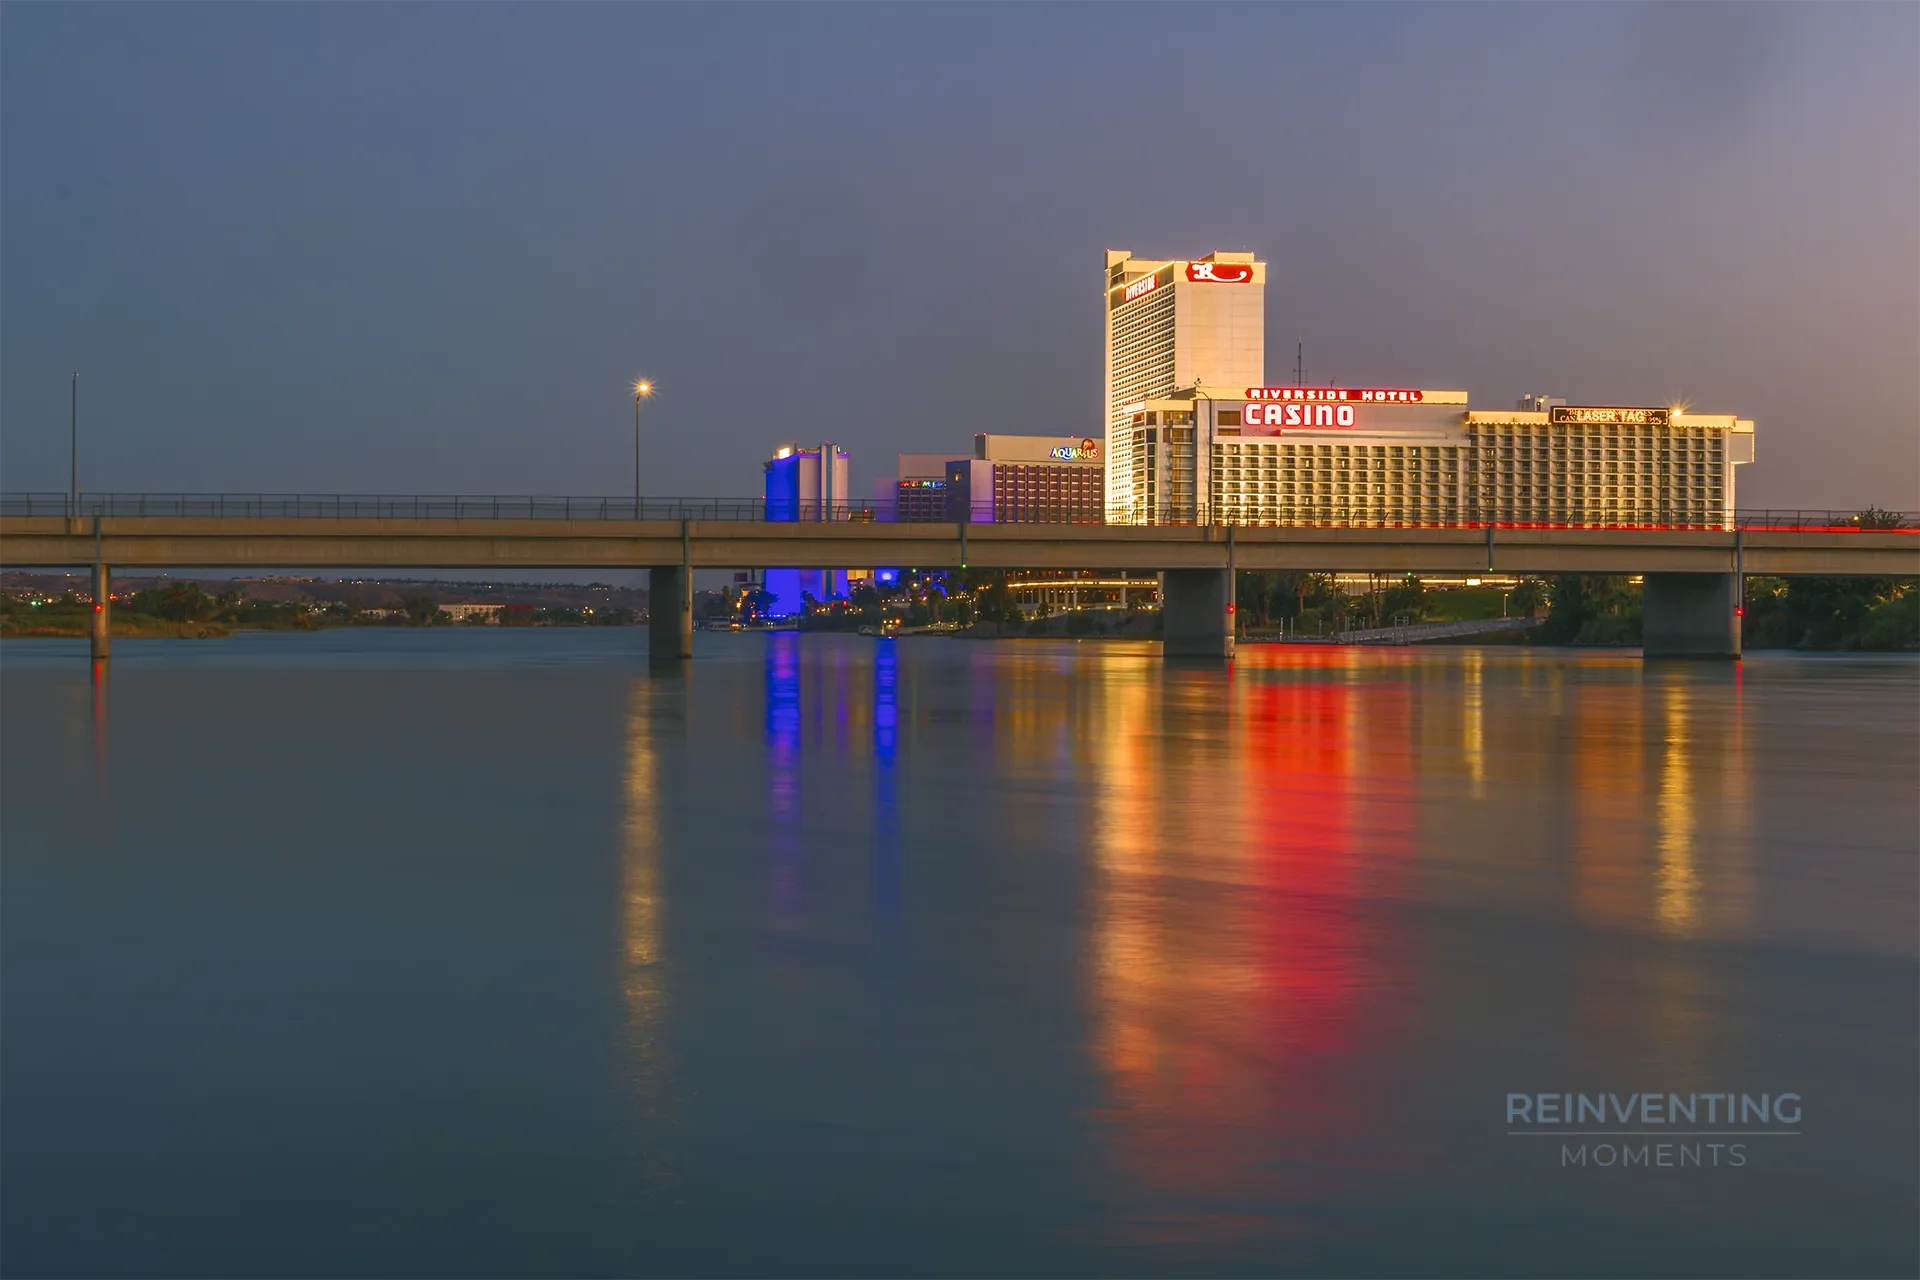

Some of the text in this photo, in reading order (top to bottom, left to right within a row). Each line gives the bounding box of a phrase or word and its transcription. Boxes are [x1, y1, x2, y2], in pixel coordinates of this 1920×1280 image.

[1125, 275, 1156, 301] RIVERSIDE
[1250, 389, 1418, 401] RIVERSIDE HOTEL
[1245, 403, 1355, 426] CASINO
[1577, 410, 1613, 422] LASER
[1618, 411, 1645, 422] TAG
[1049, 447, 1099, 460] AQUARIUS
